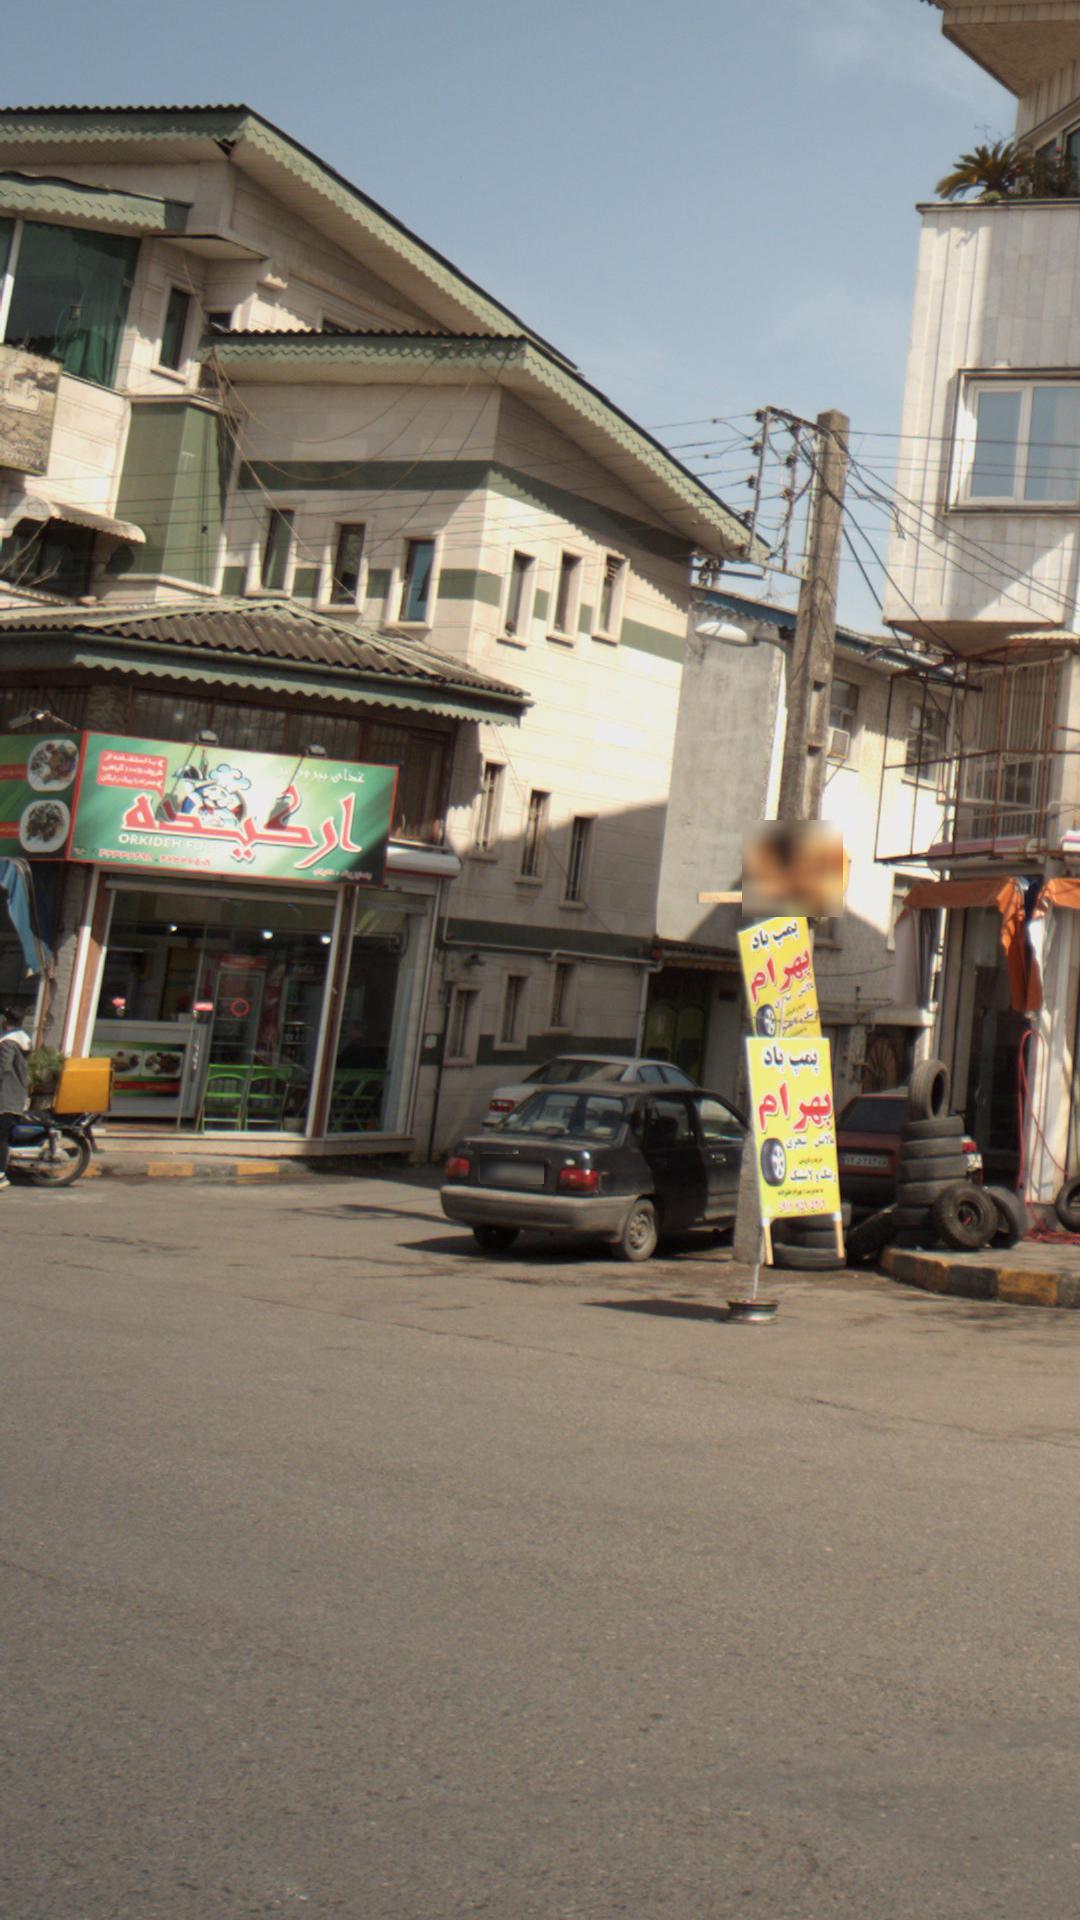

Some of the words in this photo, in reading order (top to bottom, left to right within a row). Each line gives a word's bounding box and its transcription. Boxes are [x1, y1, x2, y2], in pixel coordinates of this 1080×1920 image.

[118, 833, 182, 849] ORKIDEH
[752, 930, 769, 949] باد
[773, 922, 799, 948] پمپ
[751, 949, 810, 1003] بهرام
[764, 1045, 784, 1073] باد
[789, 1051, 819, 1075] پمپ
[759, 1082, 832, 1132] بهرام
